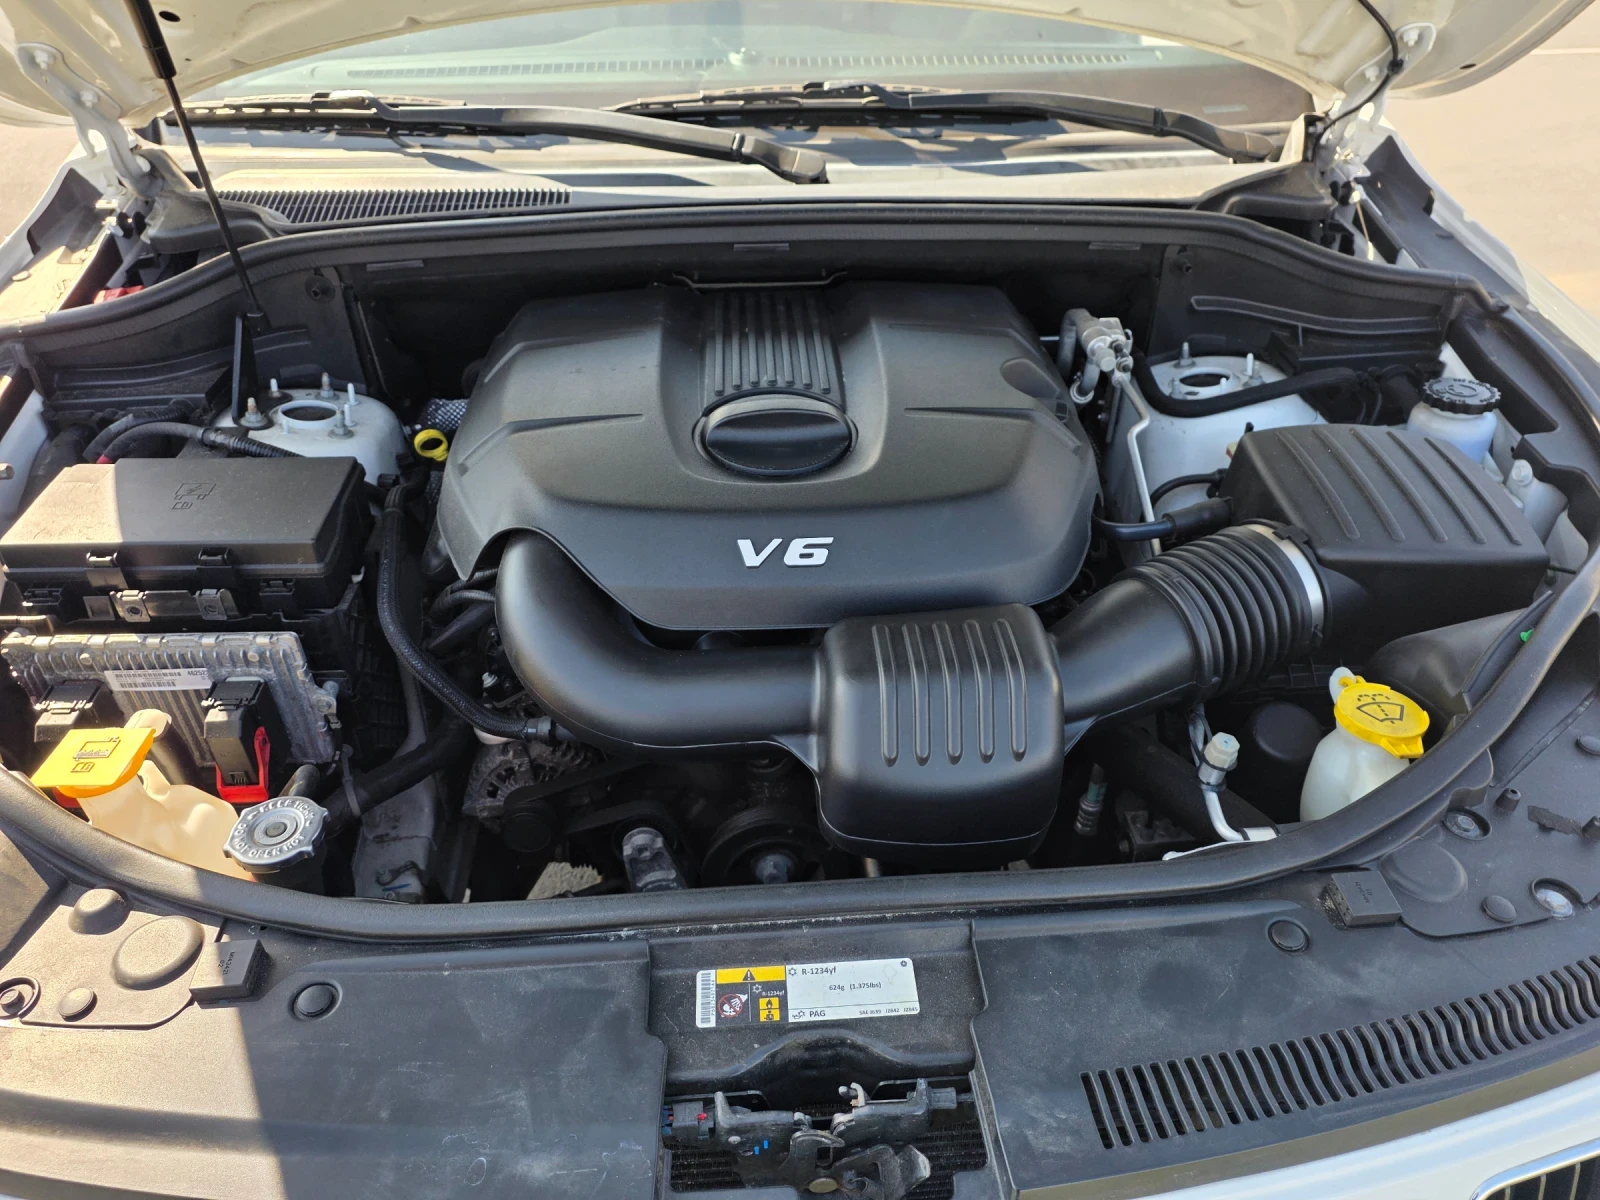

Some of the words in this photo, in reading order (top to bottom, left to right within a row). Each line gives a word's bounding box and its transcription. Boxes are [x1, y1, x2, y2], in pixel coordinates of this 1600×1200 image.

[737, 537, 834, 567] V6
[801, 966, 837, 976] R-1234yf
[849, 982, 882, 990] (1.375lbs)
[809, 1010, 826, 1018] PAG
